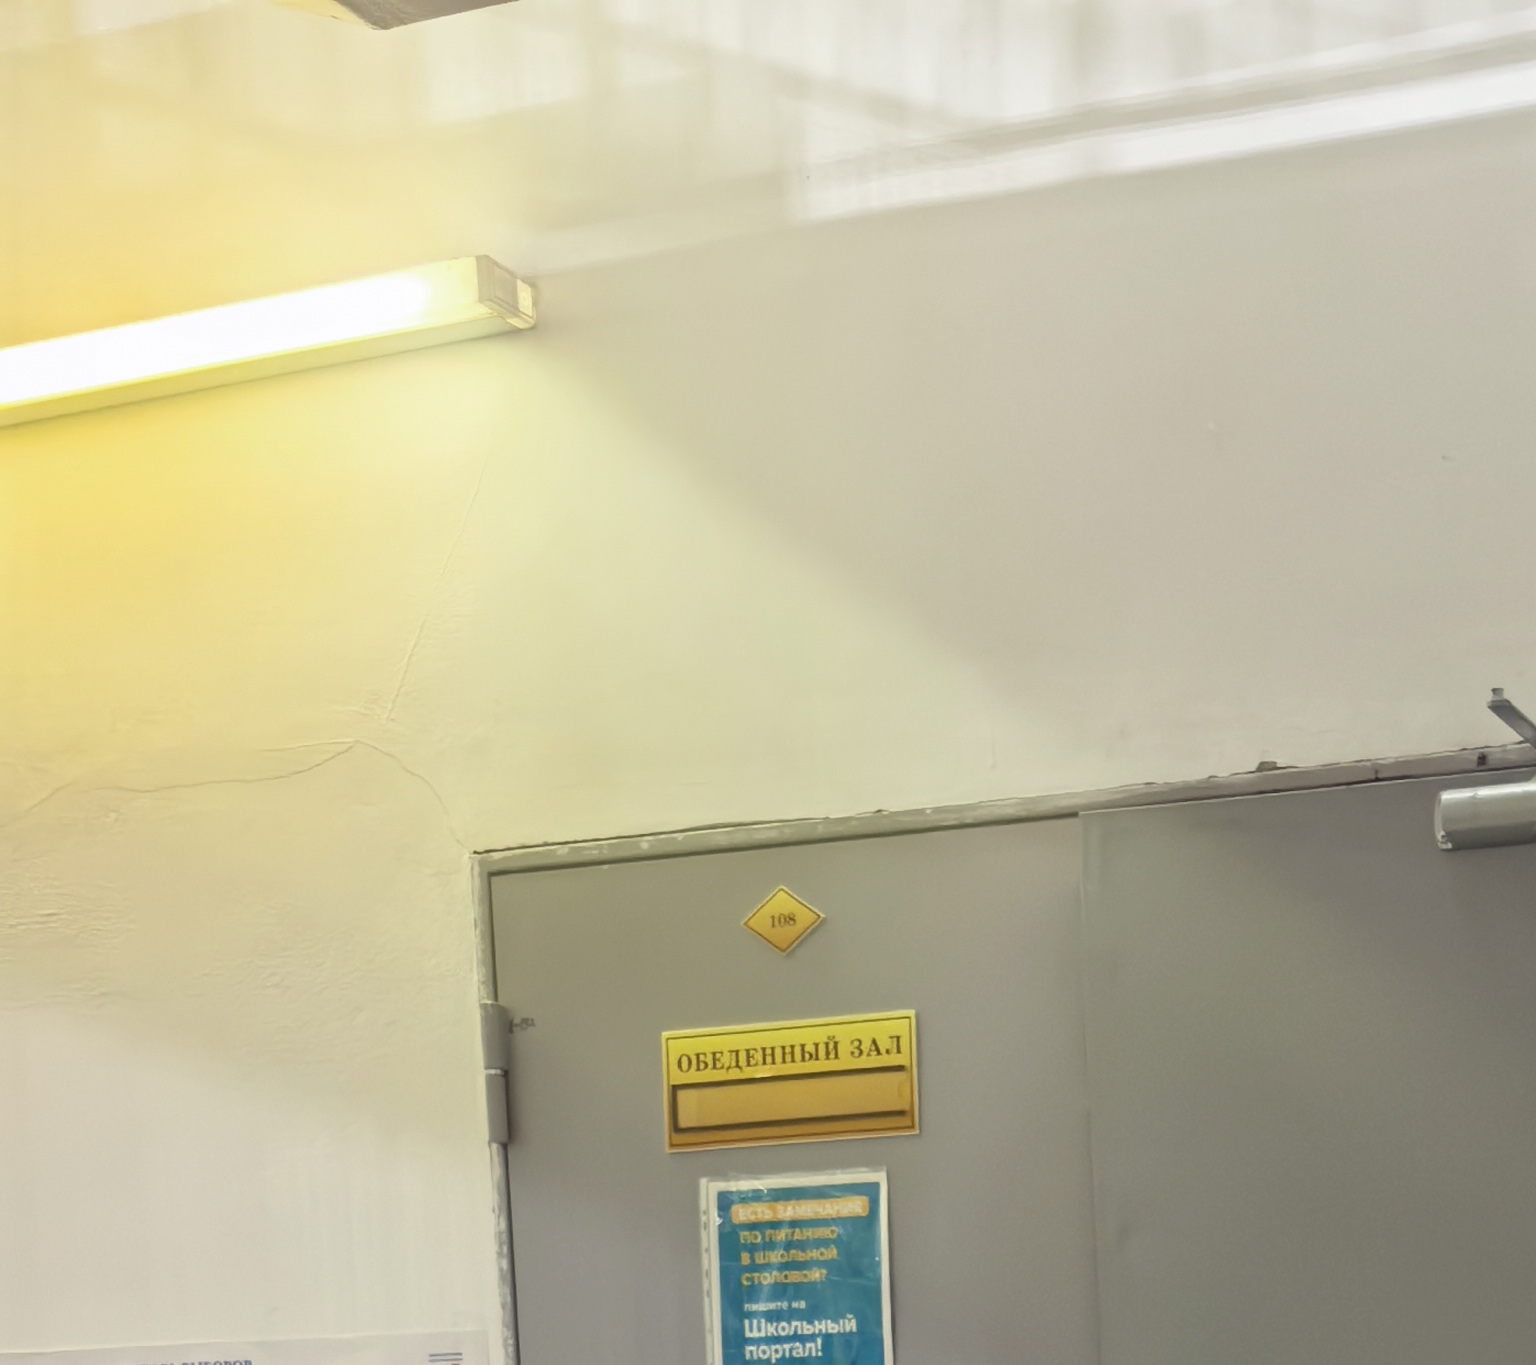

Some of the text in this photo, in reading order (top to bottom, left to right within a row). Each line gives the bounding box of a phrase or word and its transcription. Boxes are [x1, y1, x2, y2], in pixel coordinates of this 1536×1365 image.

[769, 913, 797, 928] 108
[677, 1036, 902, 1073] ОБЕДЕННЫЙ ЗАЛ
[740, 1231, 761, 1243] ПО
[754, 1245, 837, 1264] ШКОЛЬНОЙ
[744, 1300, 806, 1311] пишите на
[744, 1313, 857, 1338] Школьный
[744, 1336, 822, 1363] портал!
